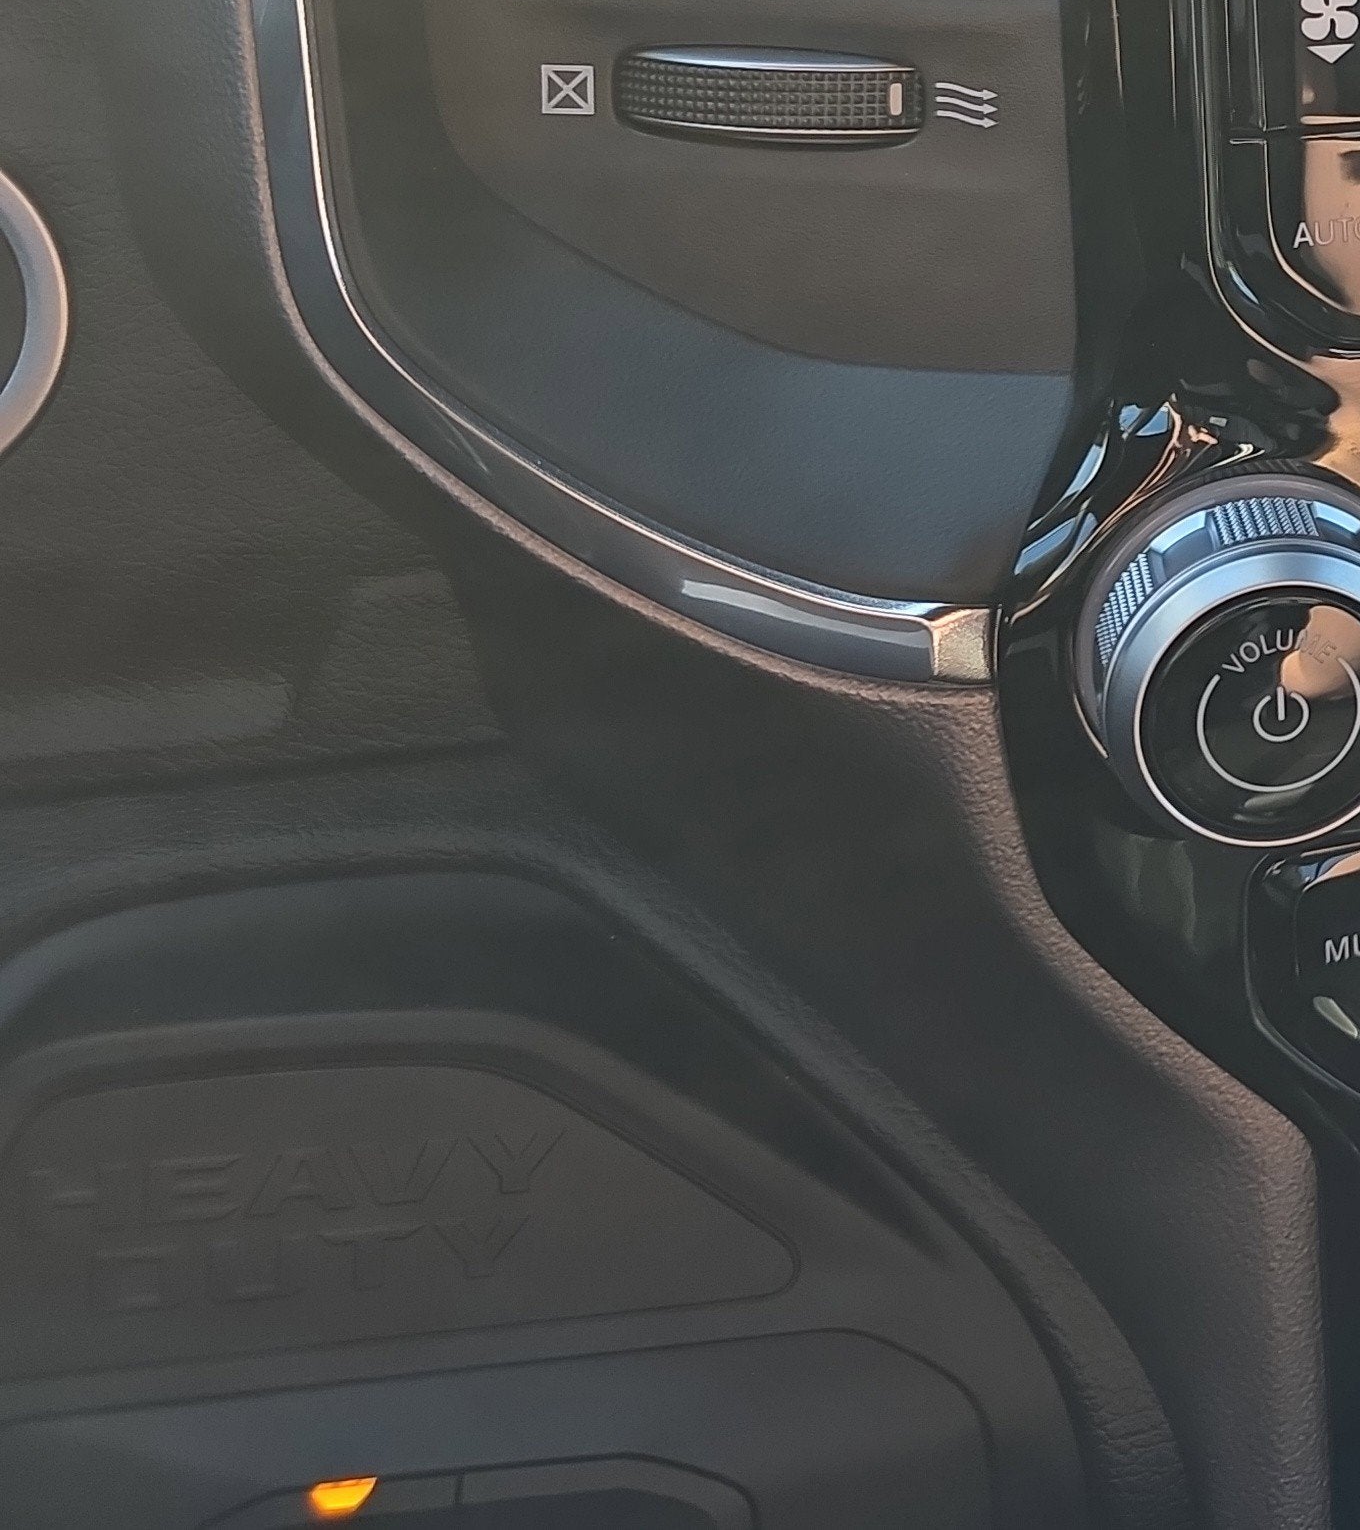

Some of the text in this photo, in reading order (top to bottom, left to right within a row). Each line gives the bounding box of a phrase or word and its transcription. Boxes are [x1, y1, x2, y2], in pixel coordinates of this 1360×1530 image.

[1221, 628, 1338, 673] VOLUME
[20, 1130, 567, 1241] HEAVY
[88, 1216, 531, 1317] DUTY
